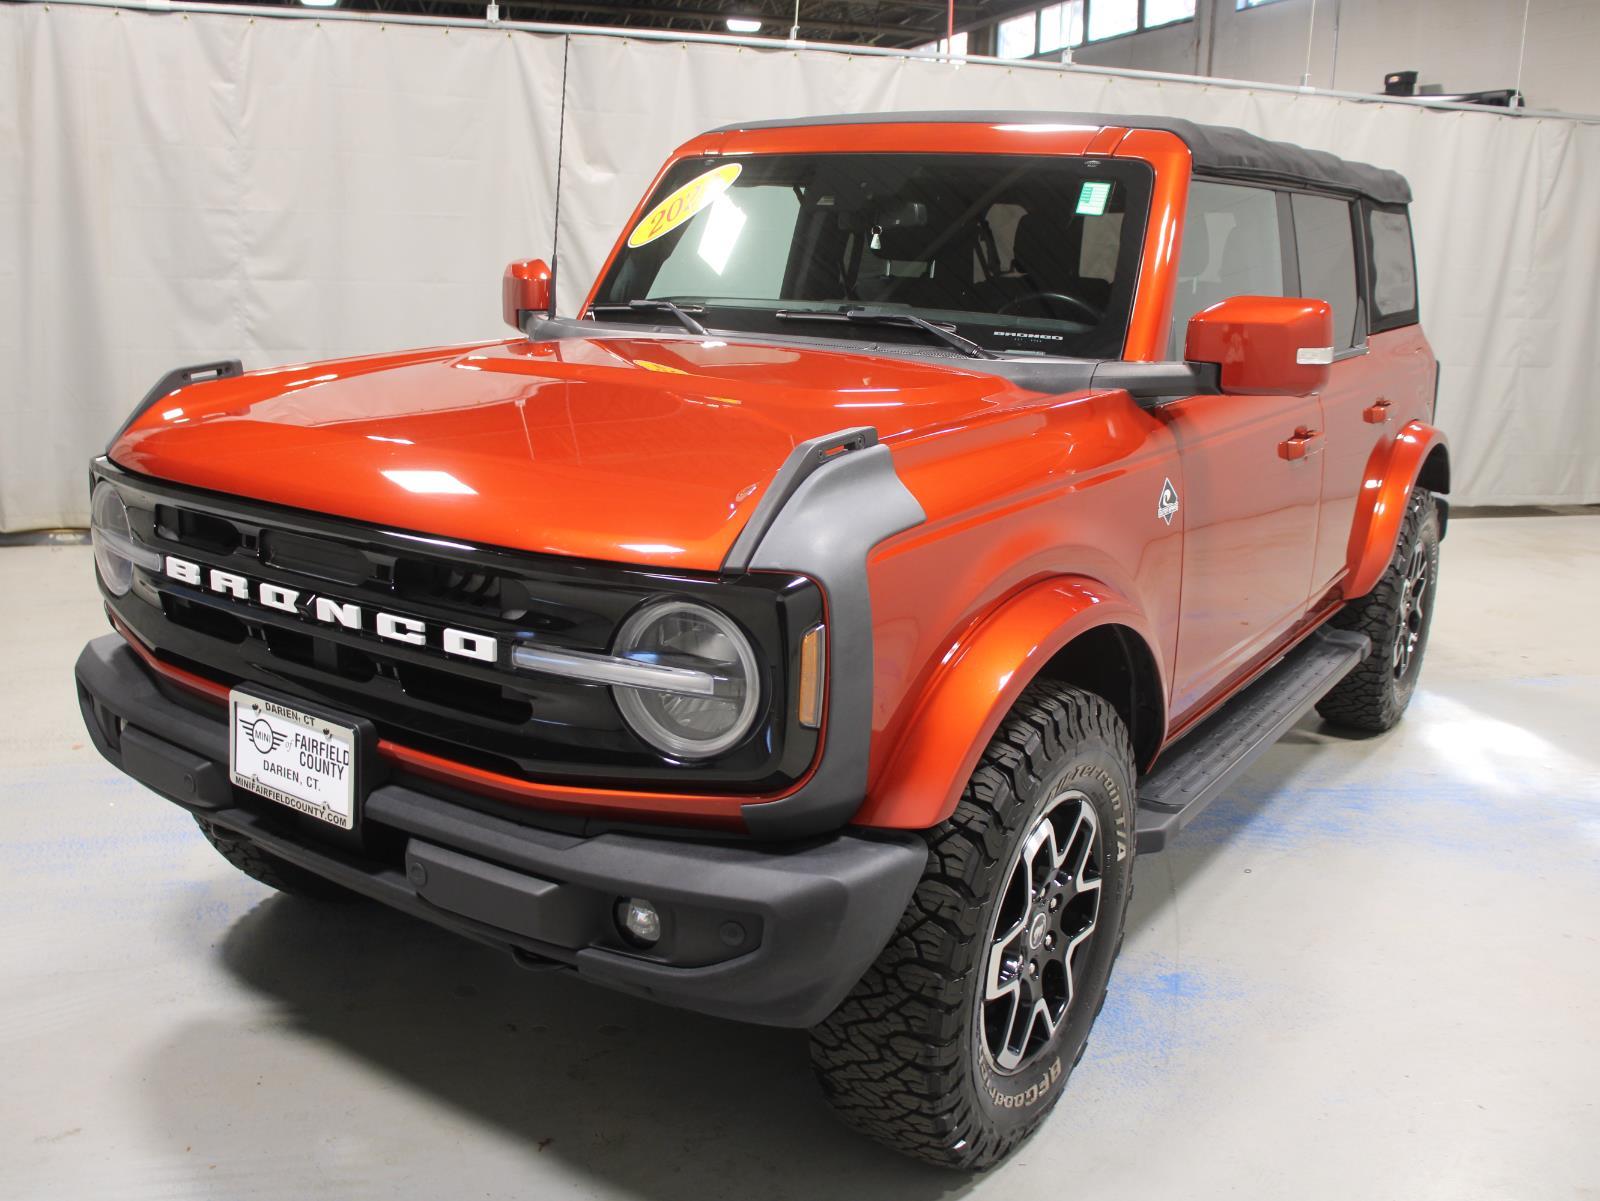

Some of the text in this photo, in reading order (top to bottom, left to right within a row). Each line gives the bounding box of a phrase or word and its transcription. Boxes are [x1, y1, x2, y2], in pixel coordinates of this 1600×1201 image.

[993, 331, 1063, 341] BRONCO
[166, 555, 498, 663] BRONCO
[265, 701, 316, 727] DARIEN, CT
[254, 730, 271, 744] MINI
[285, 733, 349, 766] of FAIRFIELD
[300, 751, 344, 781] COUNTY
[306, 776, 321, 792] CT.
[235, 776, 347, 828] MINIFAIRFIELDCOUNTY.COM
